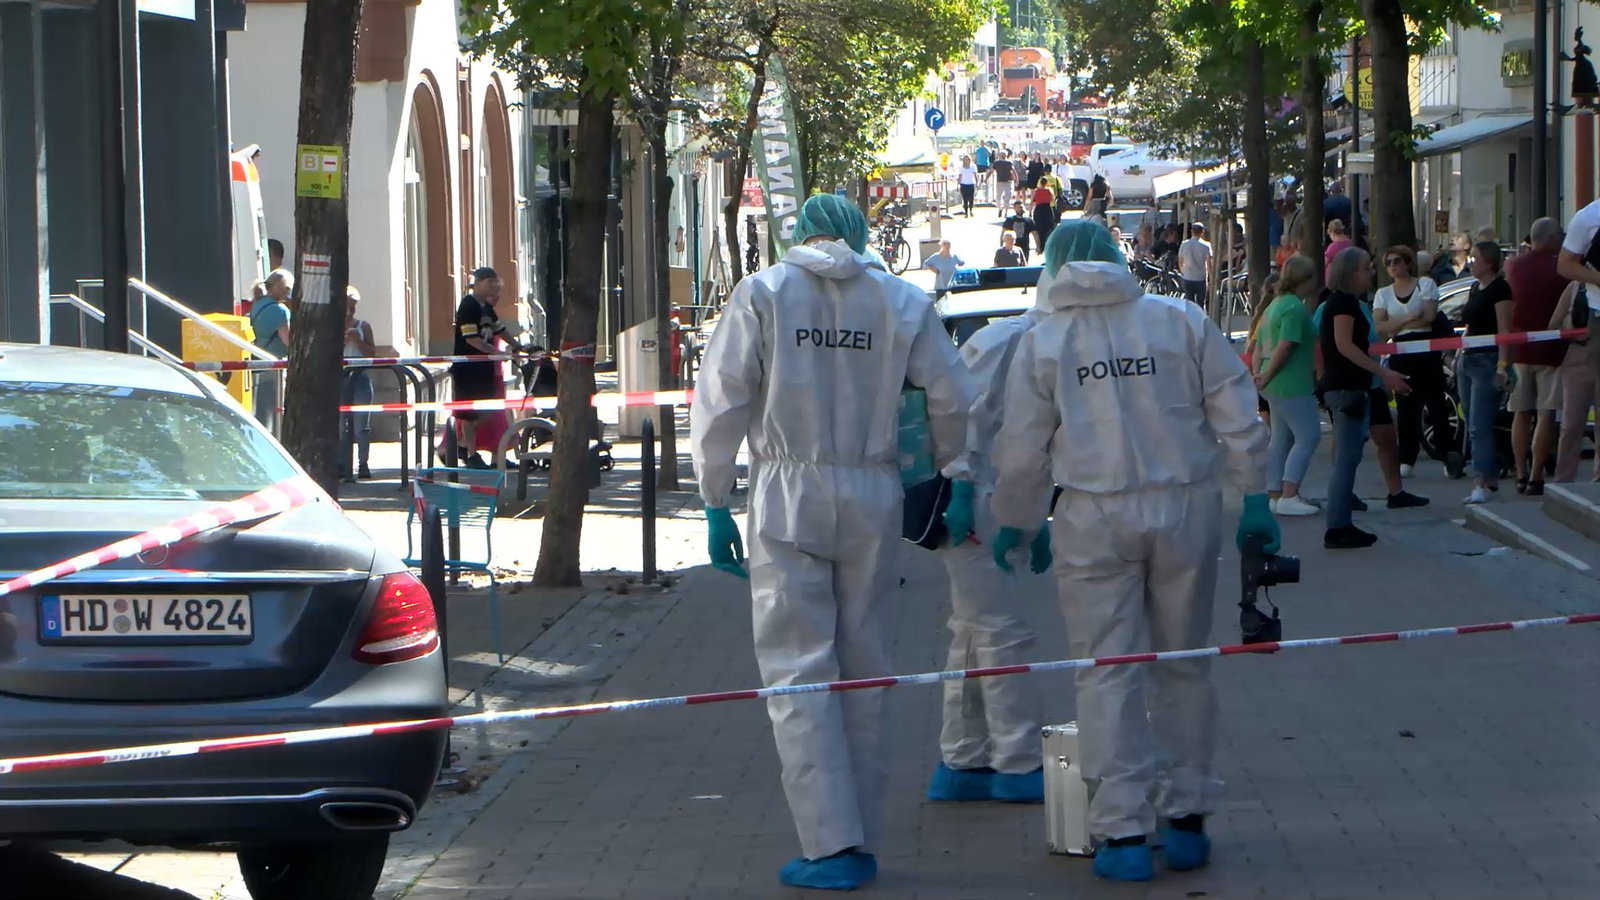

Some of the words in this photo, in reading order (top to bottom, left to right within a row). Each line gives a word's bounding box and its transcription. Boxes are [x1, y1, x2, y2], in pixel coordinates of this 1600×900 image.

[796, 328, 872, 351] POLIZEI
[1076, 356, 1156, 386] POLIZEI
[63, 599, 108, 631] HD
[132, 599, 153, 631] W
[163, 599, 247, 631] 4824
